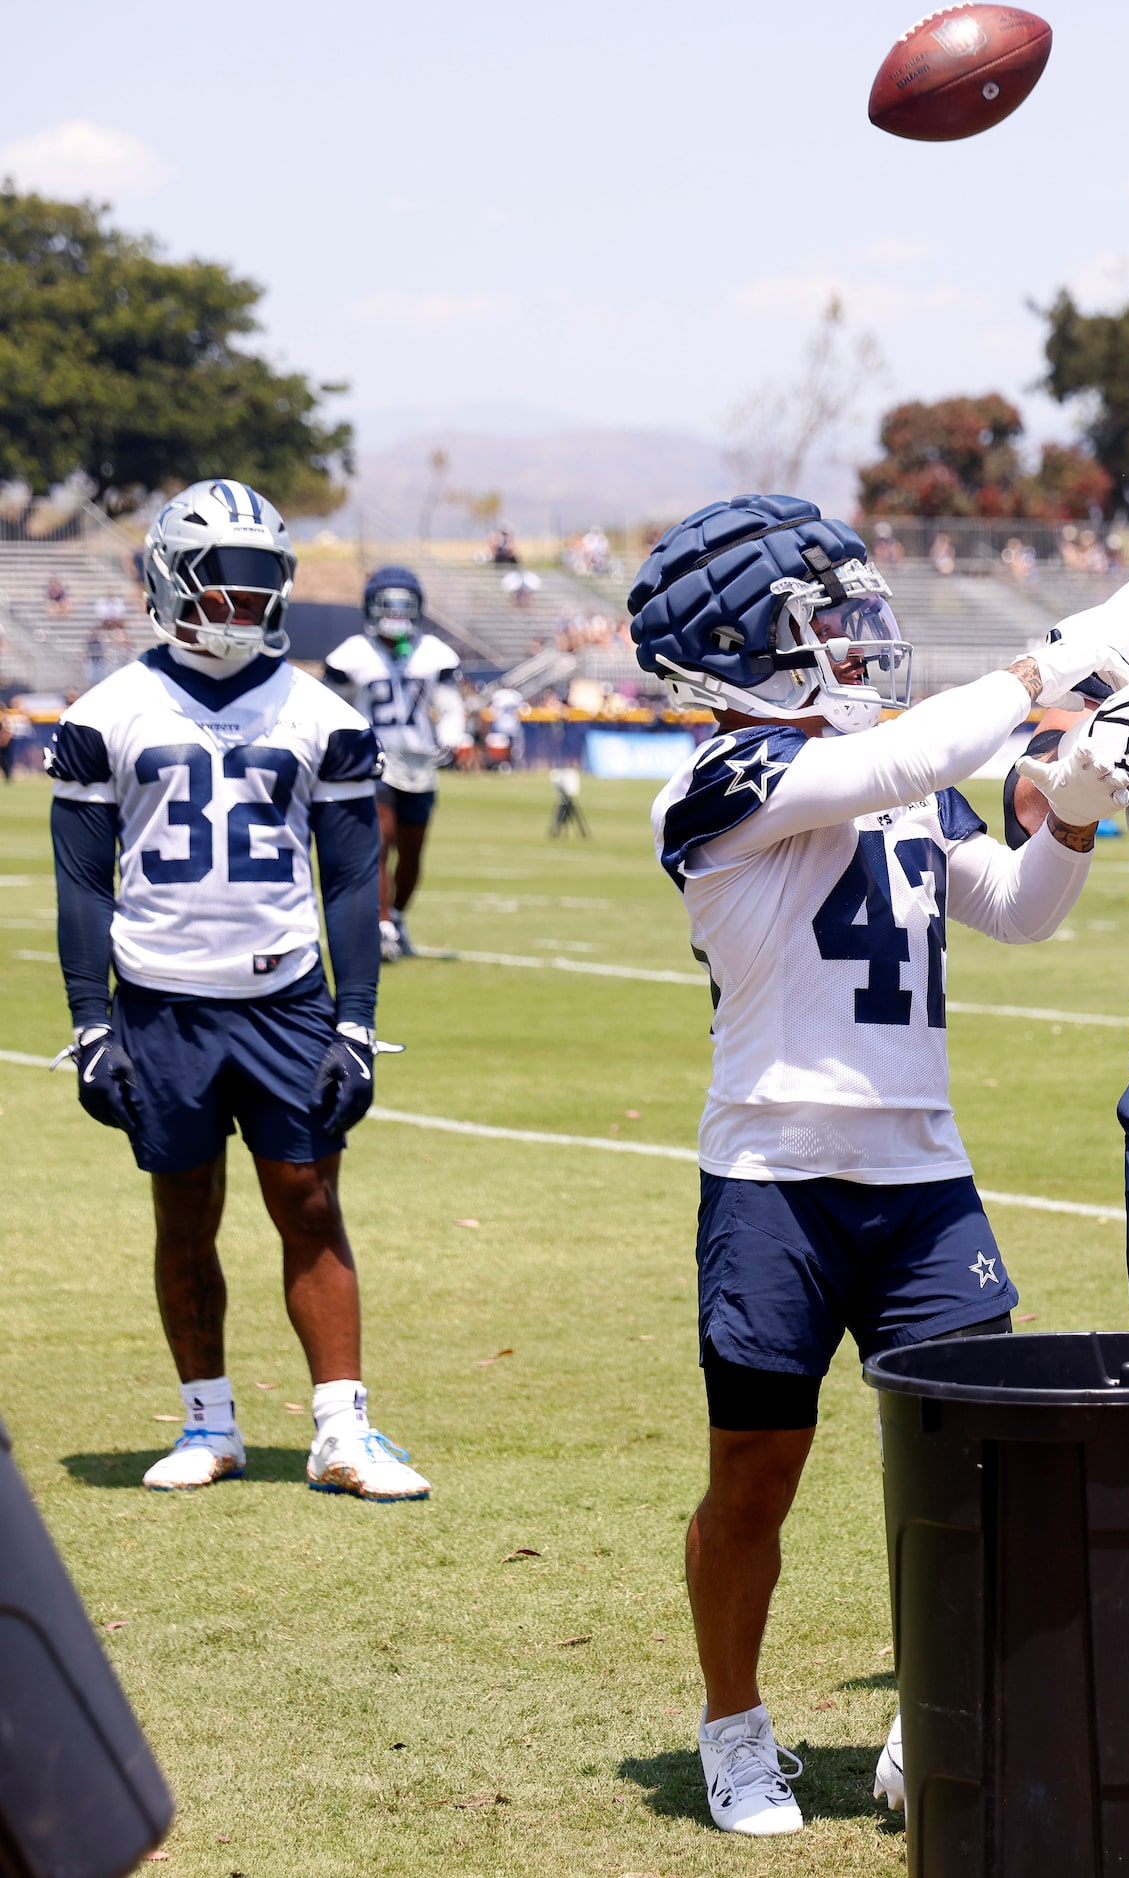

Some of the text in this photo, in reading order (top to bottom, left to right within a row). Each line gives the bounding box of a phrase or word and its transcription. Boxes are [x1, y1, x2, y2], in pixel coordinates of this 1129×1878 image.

[368, 678, 426, 727] 27
[135, 743, 299, 885] 32
[812, 829, 947, 1029] 42
